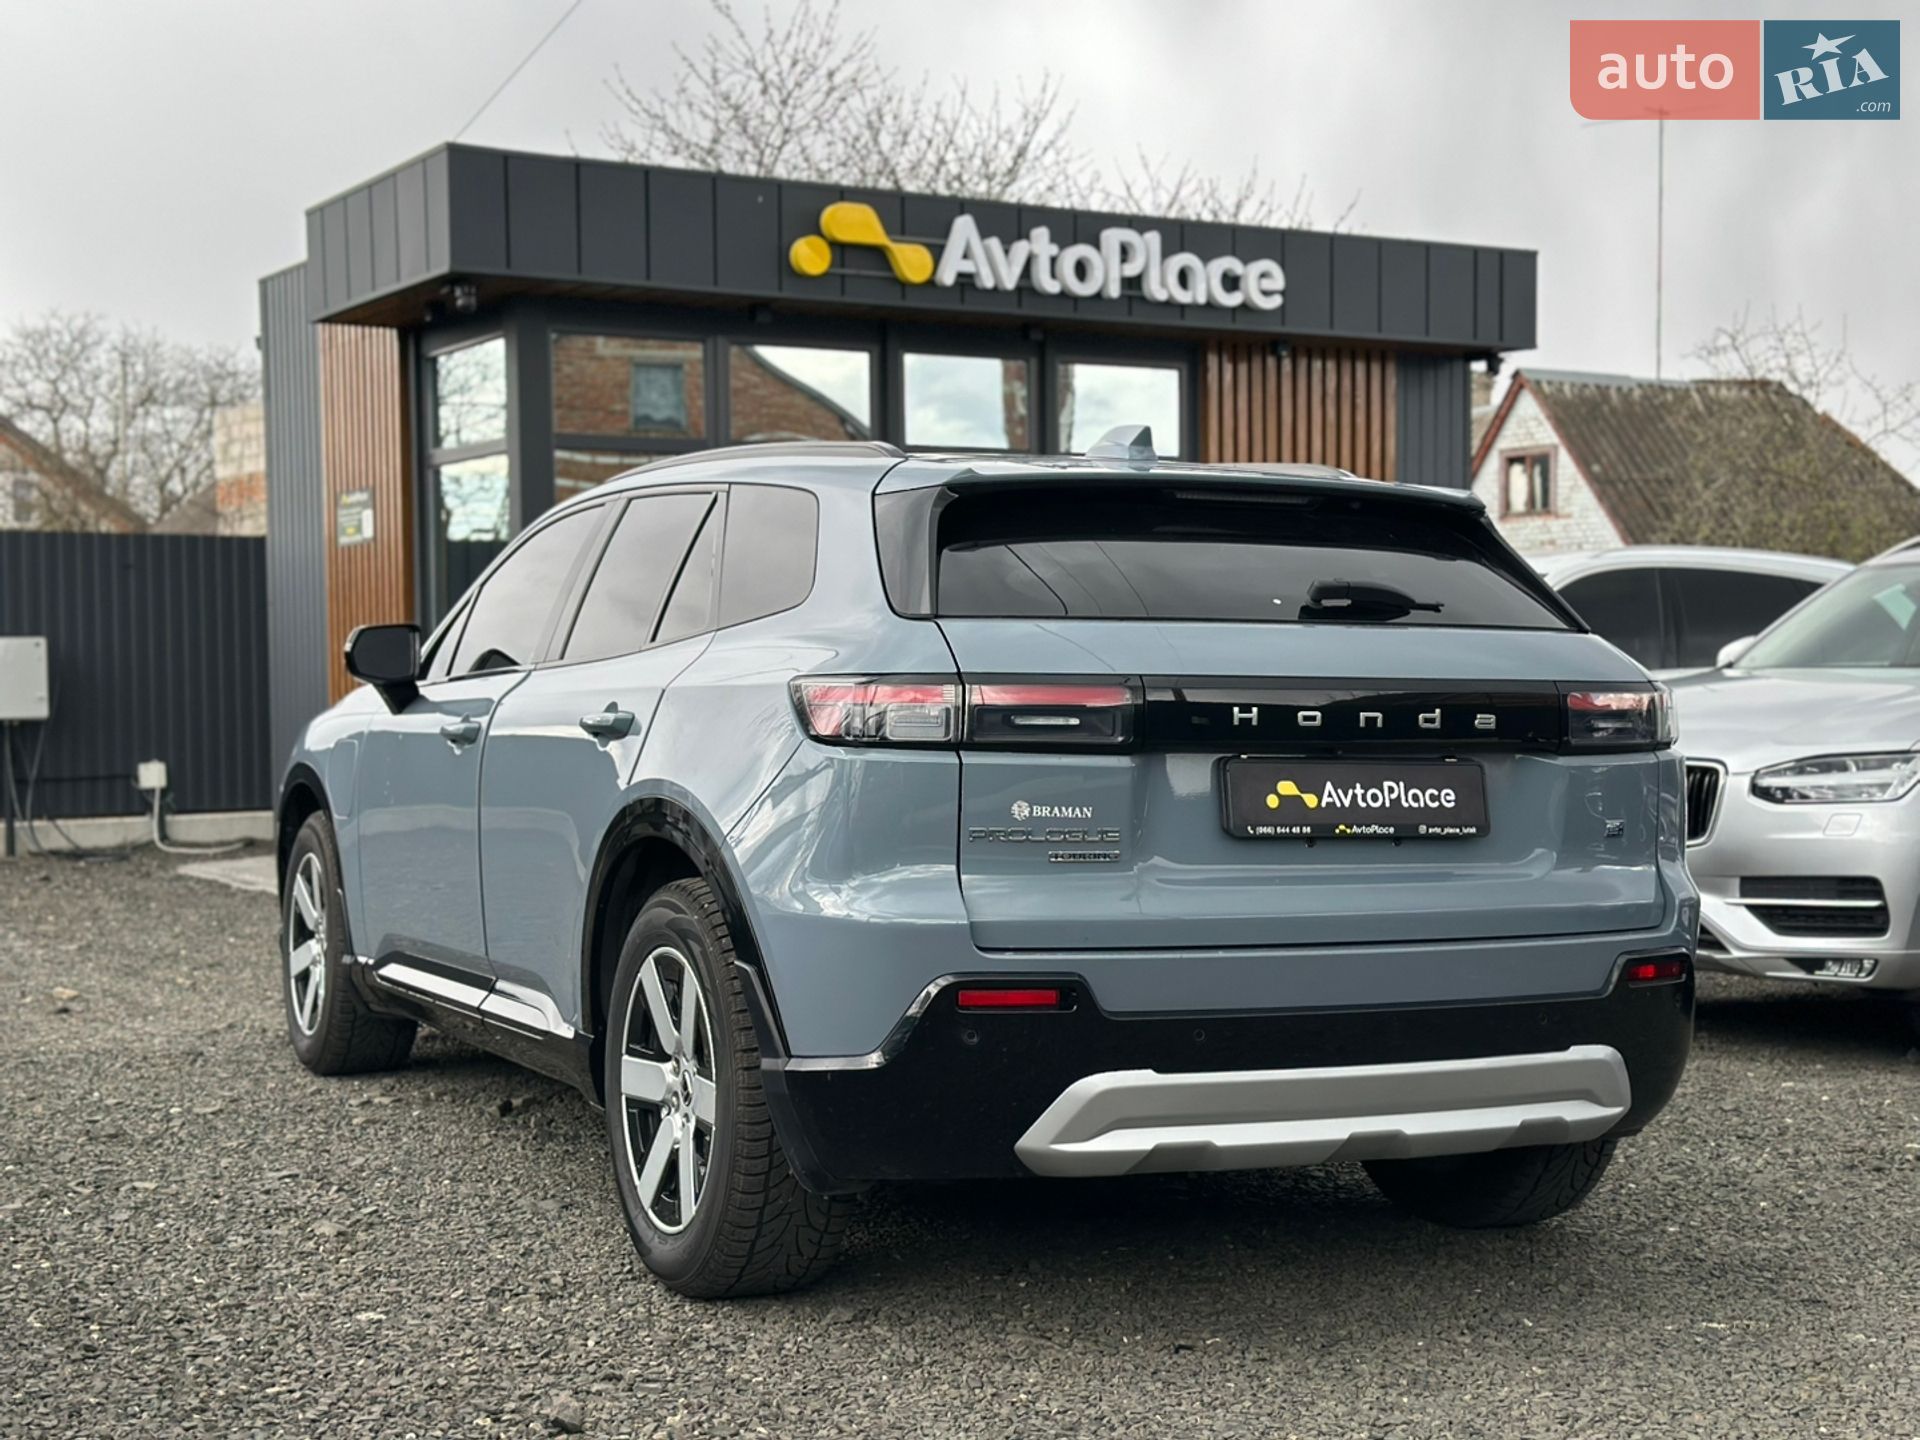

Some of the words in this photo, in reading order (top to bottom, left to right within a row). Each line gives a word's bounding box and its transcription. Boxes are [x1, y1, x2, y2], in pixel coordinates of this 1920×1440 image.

[935, 213, 1286, 311] AvtoPlace
[1233, 706, 1497, 729] Honda
[1320, 780, 1456, 808] AvtoPlace
[1032, 805, 1093, 818] BRAMAN
[968, 827, 1121, 843] PROLOGUE
[1351, 824, 1395, 835] AvtoPlace
